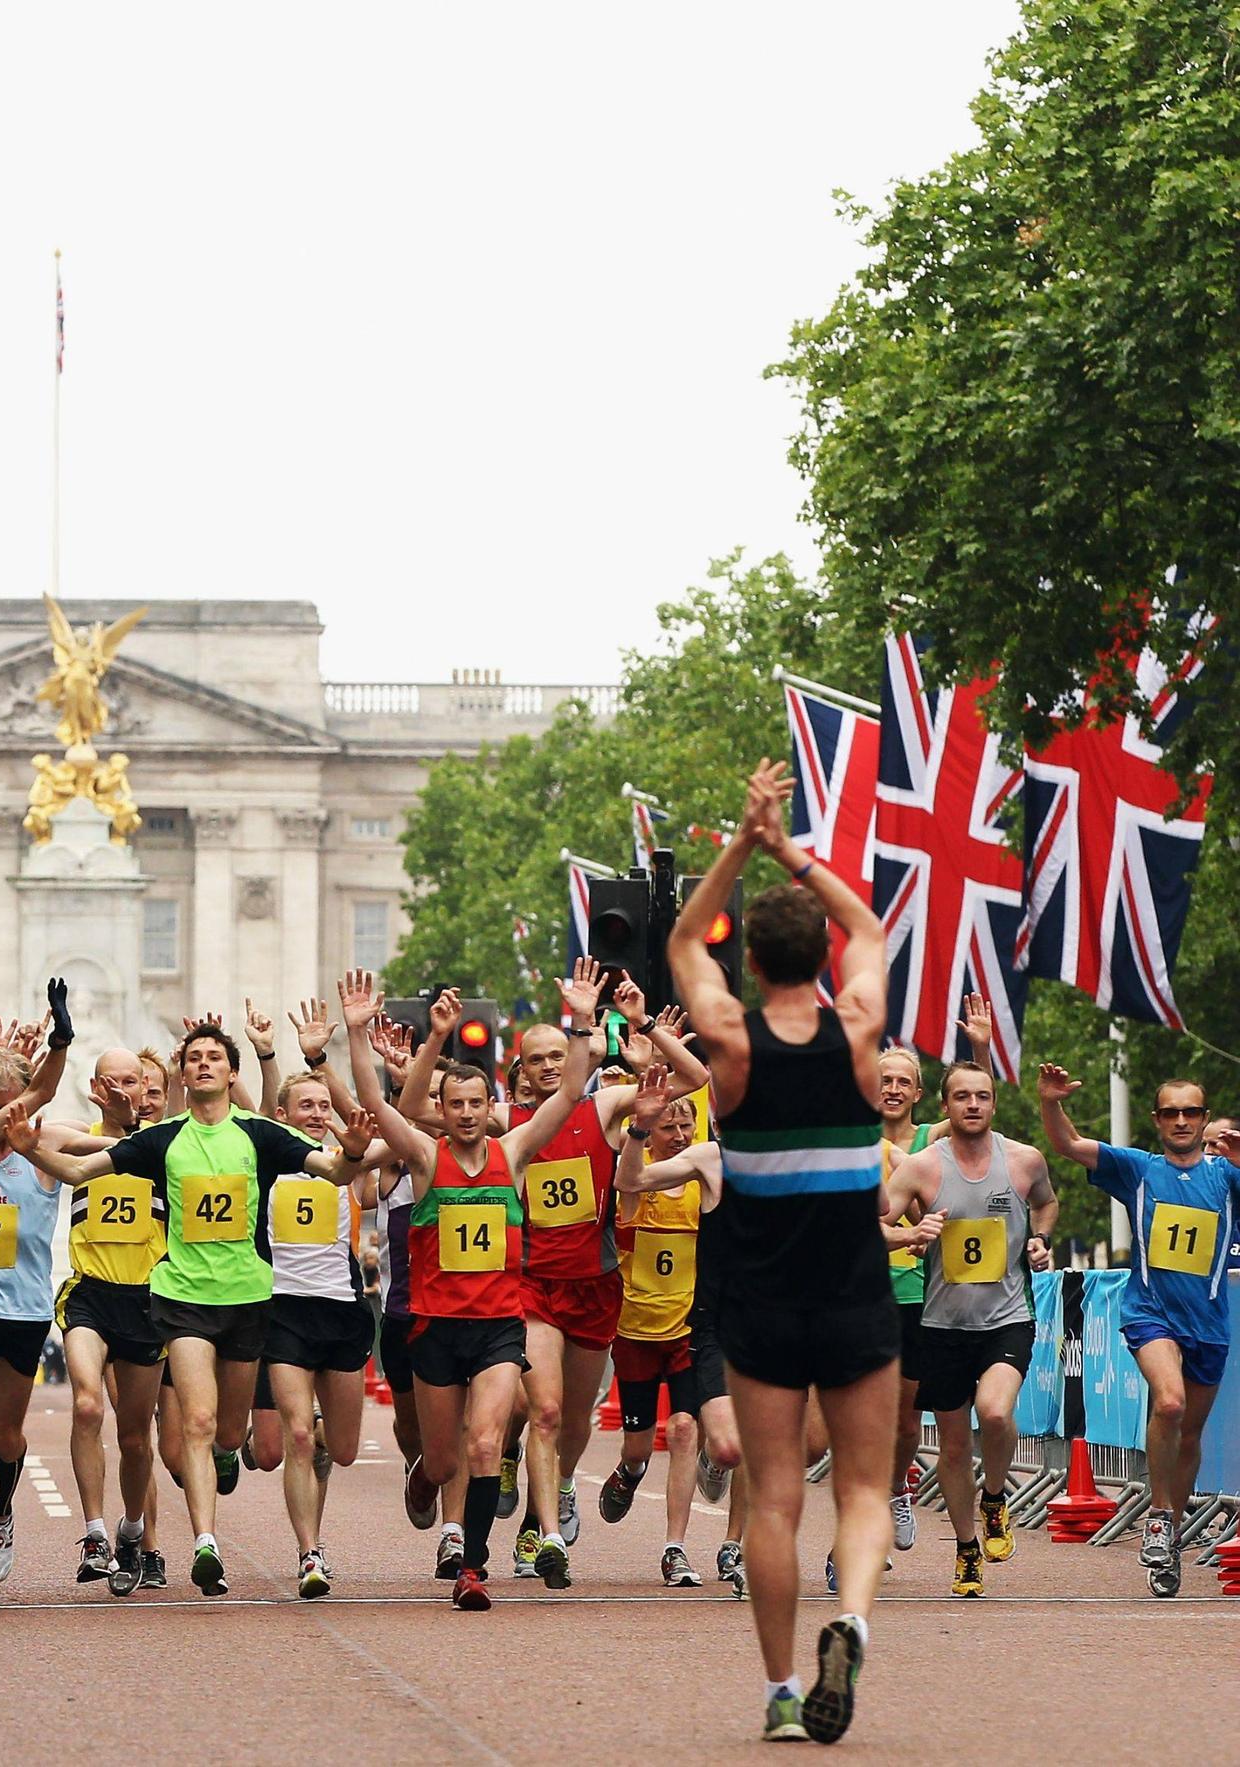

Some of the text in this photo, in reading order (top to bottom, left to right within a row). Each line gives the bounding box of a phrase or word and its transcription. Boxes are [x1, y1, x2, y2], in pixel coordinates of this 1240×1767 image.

[542, 1178, 578, 1208] 38
[101, 1197, 135, 1224] 25
[196, 1194, 232, 1222] 42
[297, 1199, 313, 1225] 5
[456, 1224, 490, 1251] 14
[964, 1238, 982, 1264] 8
[1168, 1224, 1197, 1254] 11
[656, 1250, 673, 1275] 6
